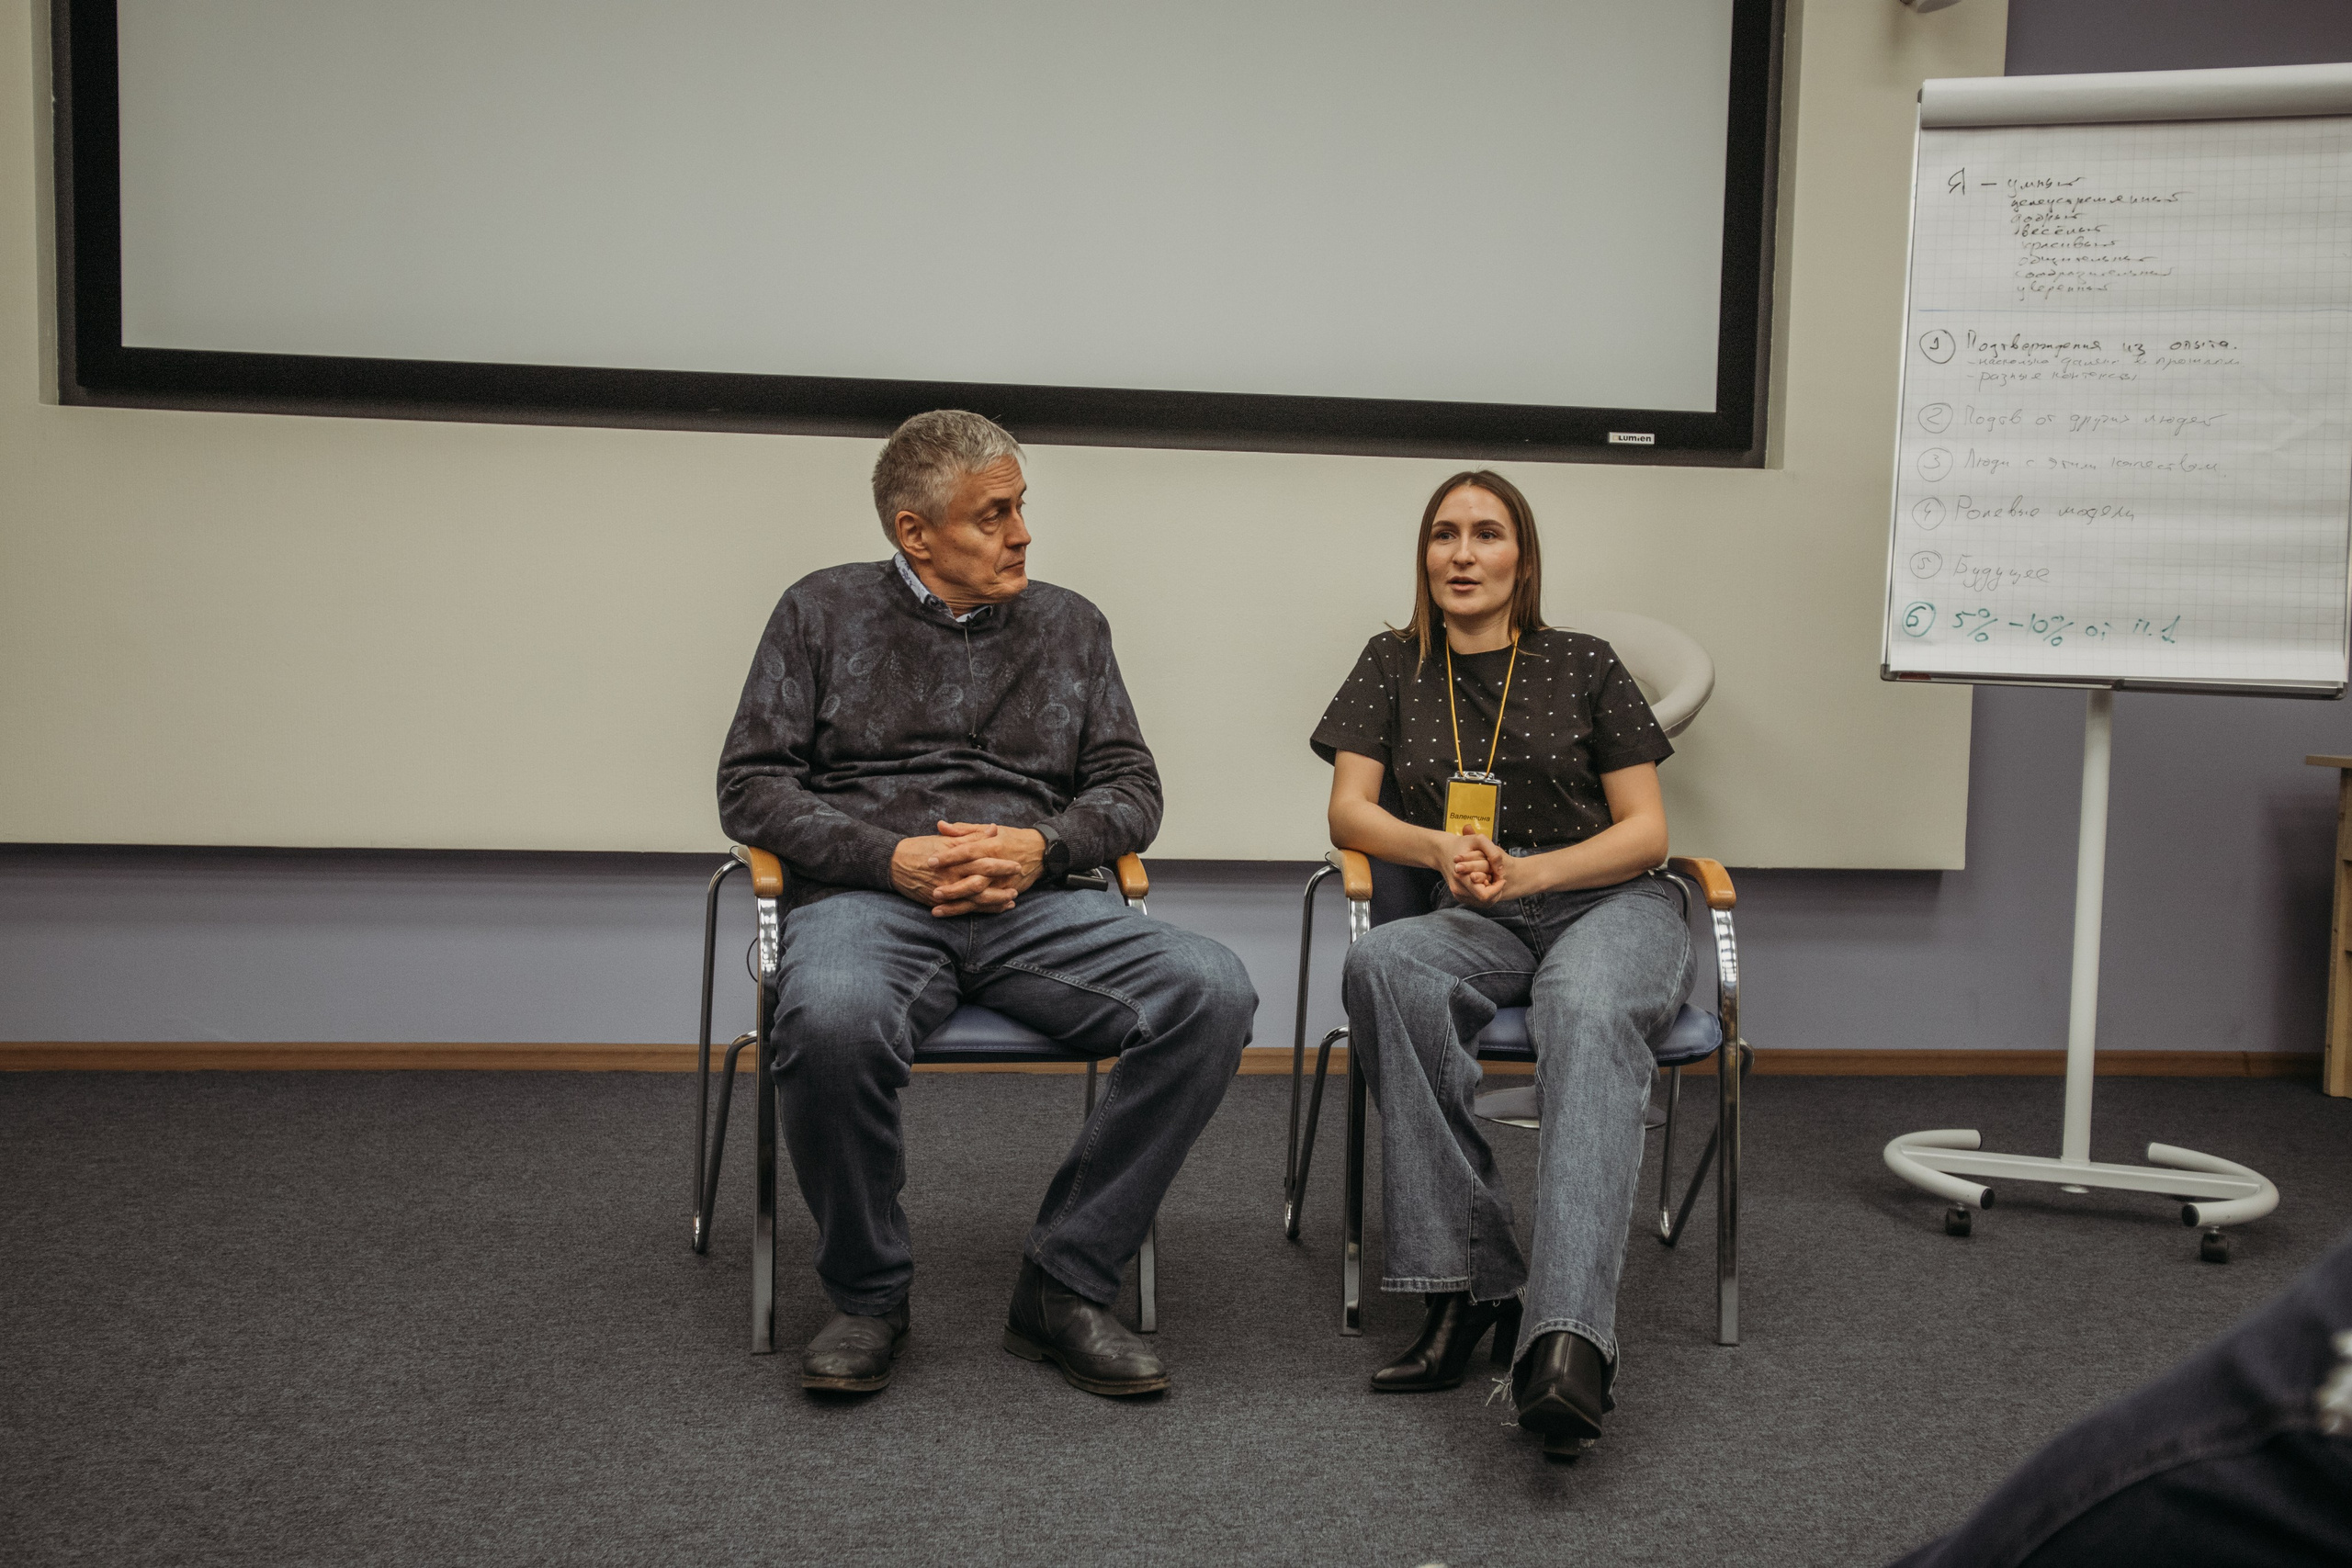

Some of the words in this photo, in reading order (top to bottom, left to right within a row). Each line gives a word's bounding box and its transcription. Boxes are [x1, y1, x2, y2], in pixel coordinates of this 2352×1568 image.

[1948, 167, 1965, 196] Я
[1966, 330, 2102, 357] Подтверждения
[2122, 343, 2146, 356] из
[2035, 414, 2056, 426] от
[1964, 448, 2010, 474] Люди
[2058, 504, 2135, 525] модели
[1953, 554, 2051, 592] Будущее
[1449, 812, 1491, 822] Валентина
